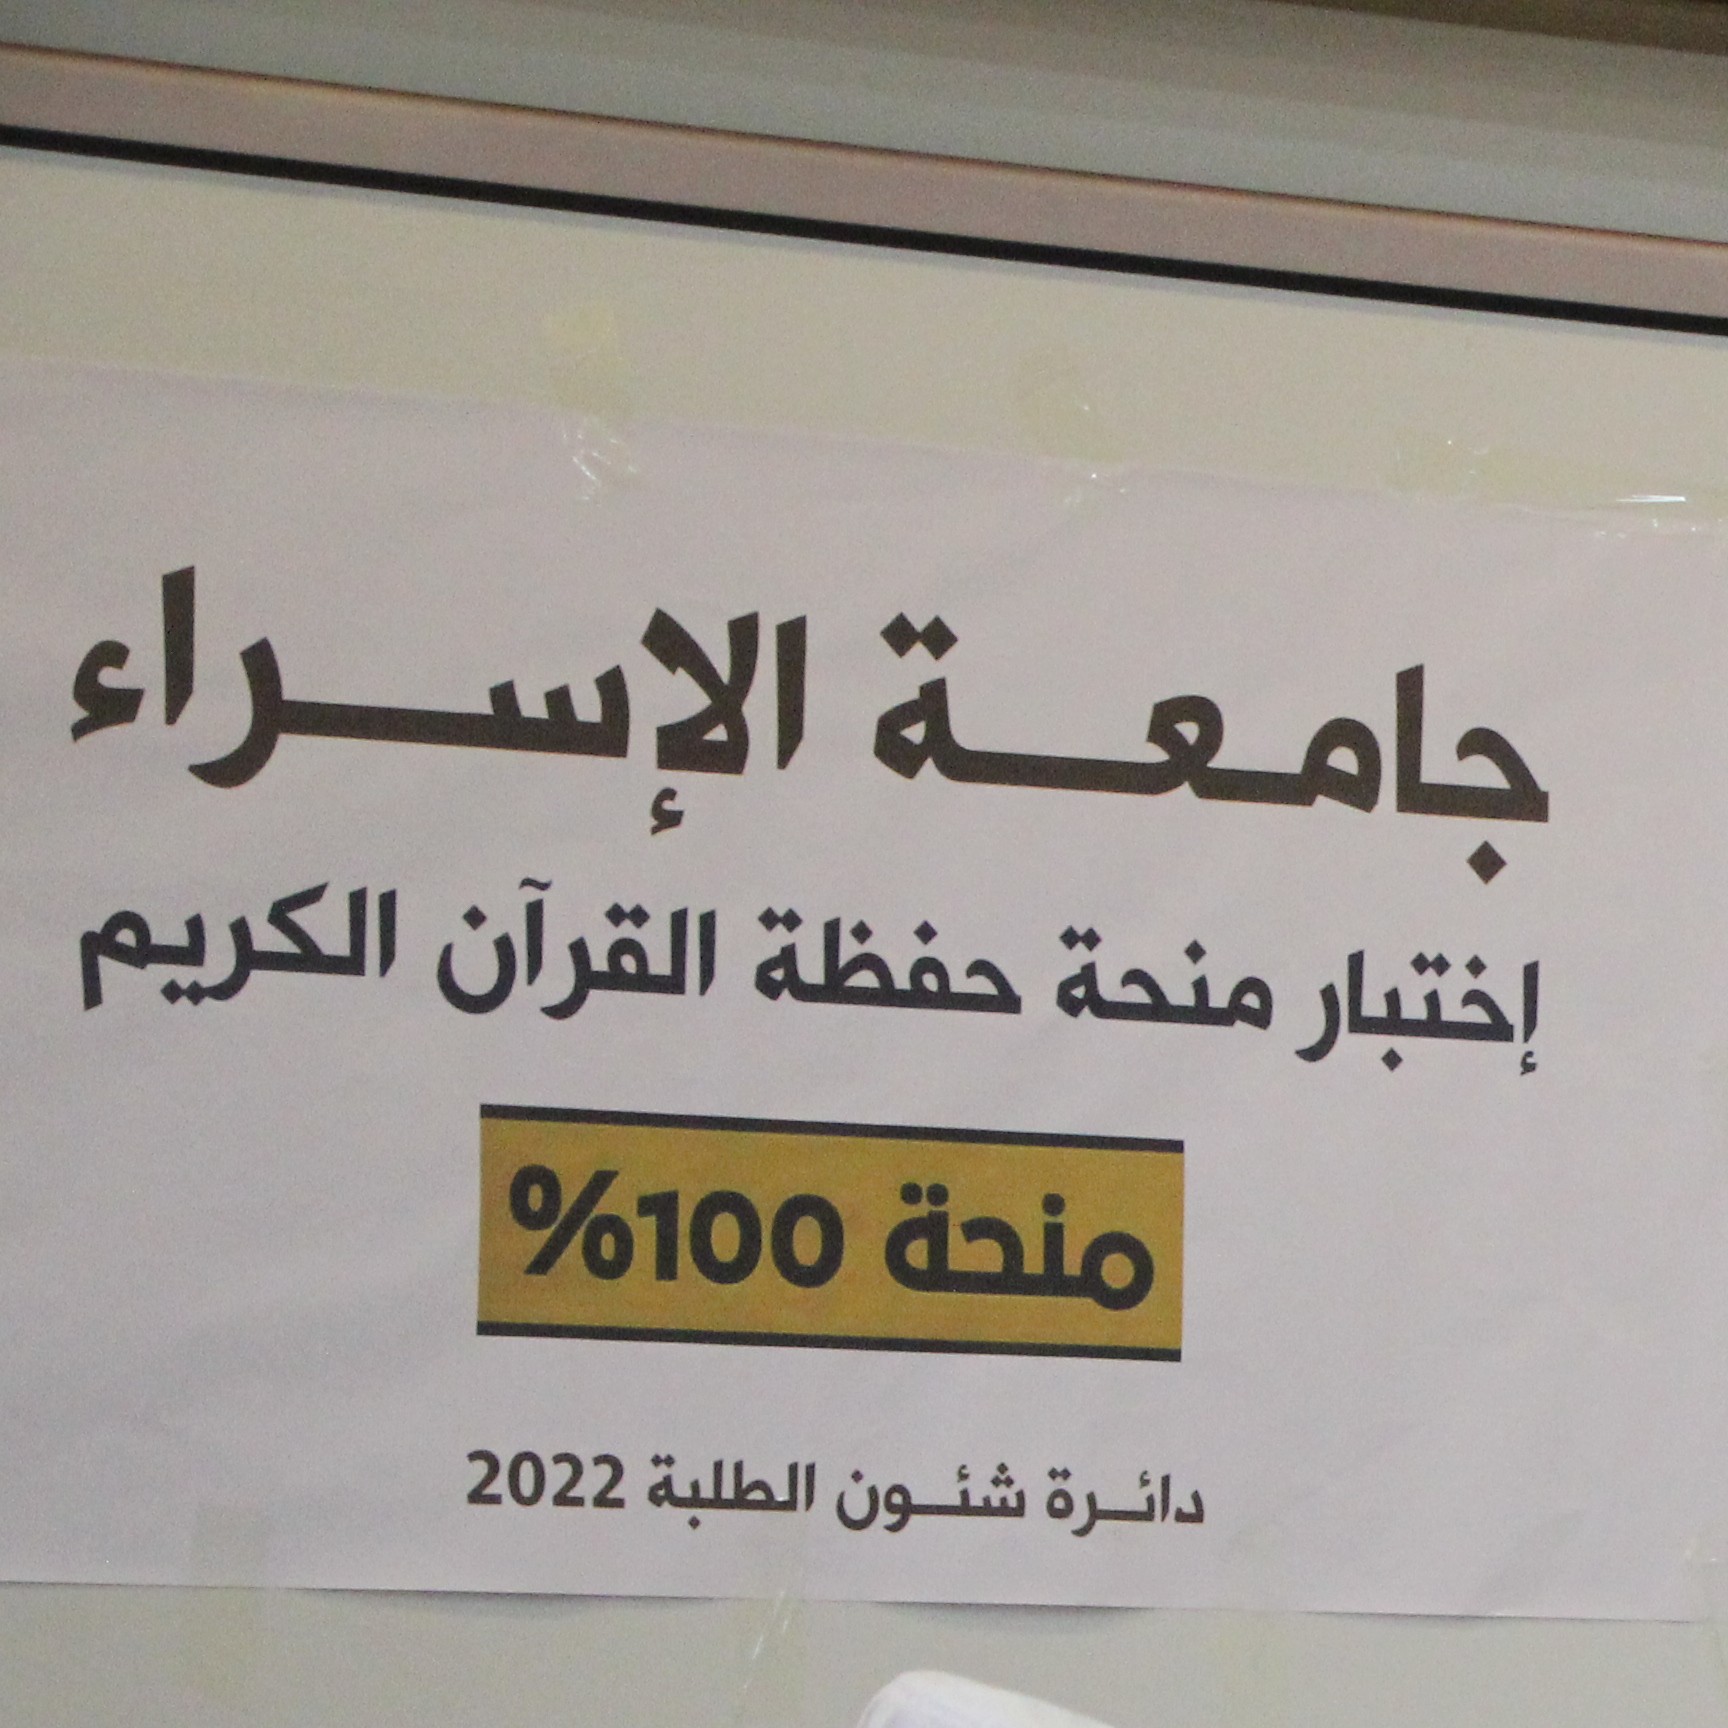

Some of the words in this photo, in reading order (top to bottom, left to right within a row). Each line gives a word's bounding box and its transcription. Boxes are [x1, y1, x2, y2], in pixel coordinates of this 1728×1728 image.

[69, 564, 809, 836] الإسراء
[871, 610, 1550, 884] جامعة
[78, 882, 399, 1011] الكريم
[435, 876, 719, 1021] القرآن
[752, 906, 1023, 1016] حفظة
[1055, 925, 1274, 1031] منحة
[1294, 947, 1541, 1076] إختبار
[884, 1181, 1155, 1311] منحة
[465, 1447, 627, 1510] 2022
[646, 1453, 818, 1529] الطلبة
[834, 1461, 1028, 1534] شئون
[1044, 1467, 1207, 1538] دائرة
